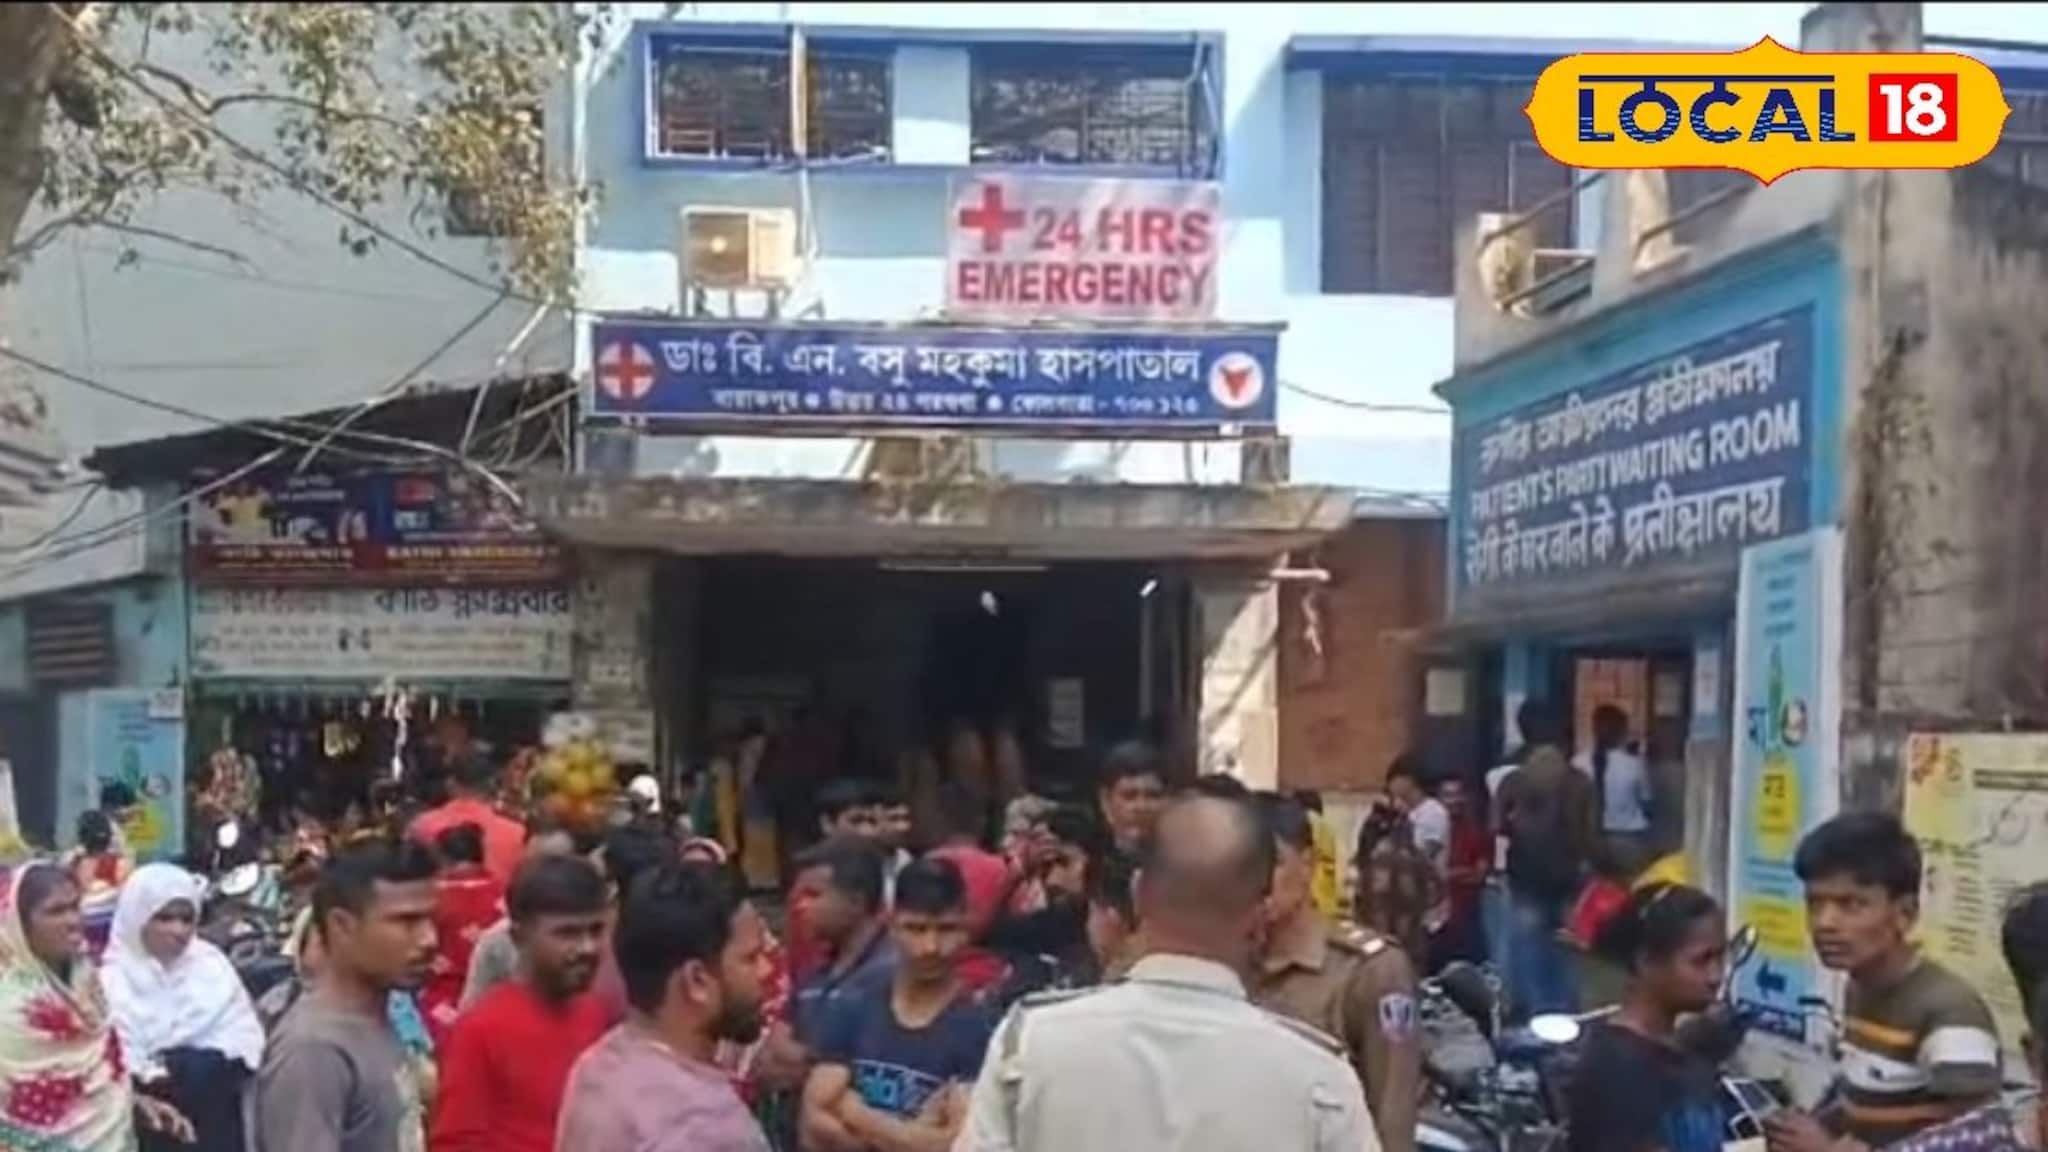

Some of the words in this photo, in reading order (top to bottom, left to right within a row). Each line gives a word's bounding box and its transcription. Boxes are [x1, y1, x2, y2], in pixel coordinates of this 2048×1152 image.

[1032, 207, 1081, 251] 24
[1096, 206, 1210, 253] HRS
[958, 261, 1208, 305] EMERGENCY
[726, 331, 773, 376] বি.
[783, 344, 846, 376] এন.
[853, 344, 912, 388] বসু
[914, 345, 1026, 390] মহকুমা
[1032, 347, 1202, 384] হাসপাতাল
[1608, 428, 1704, 490] WAITING
[1709, 399, 1798, 467] ROOM
